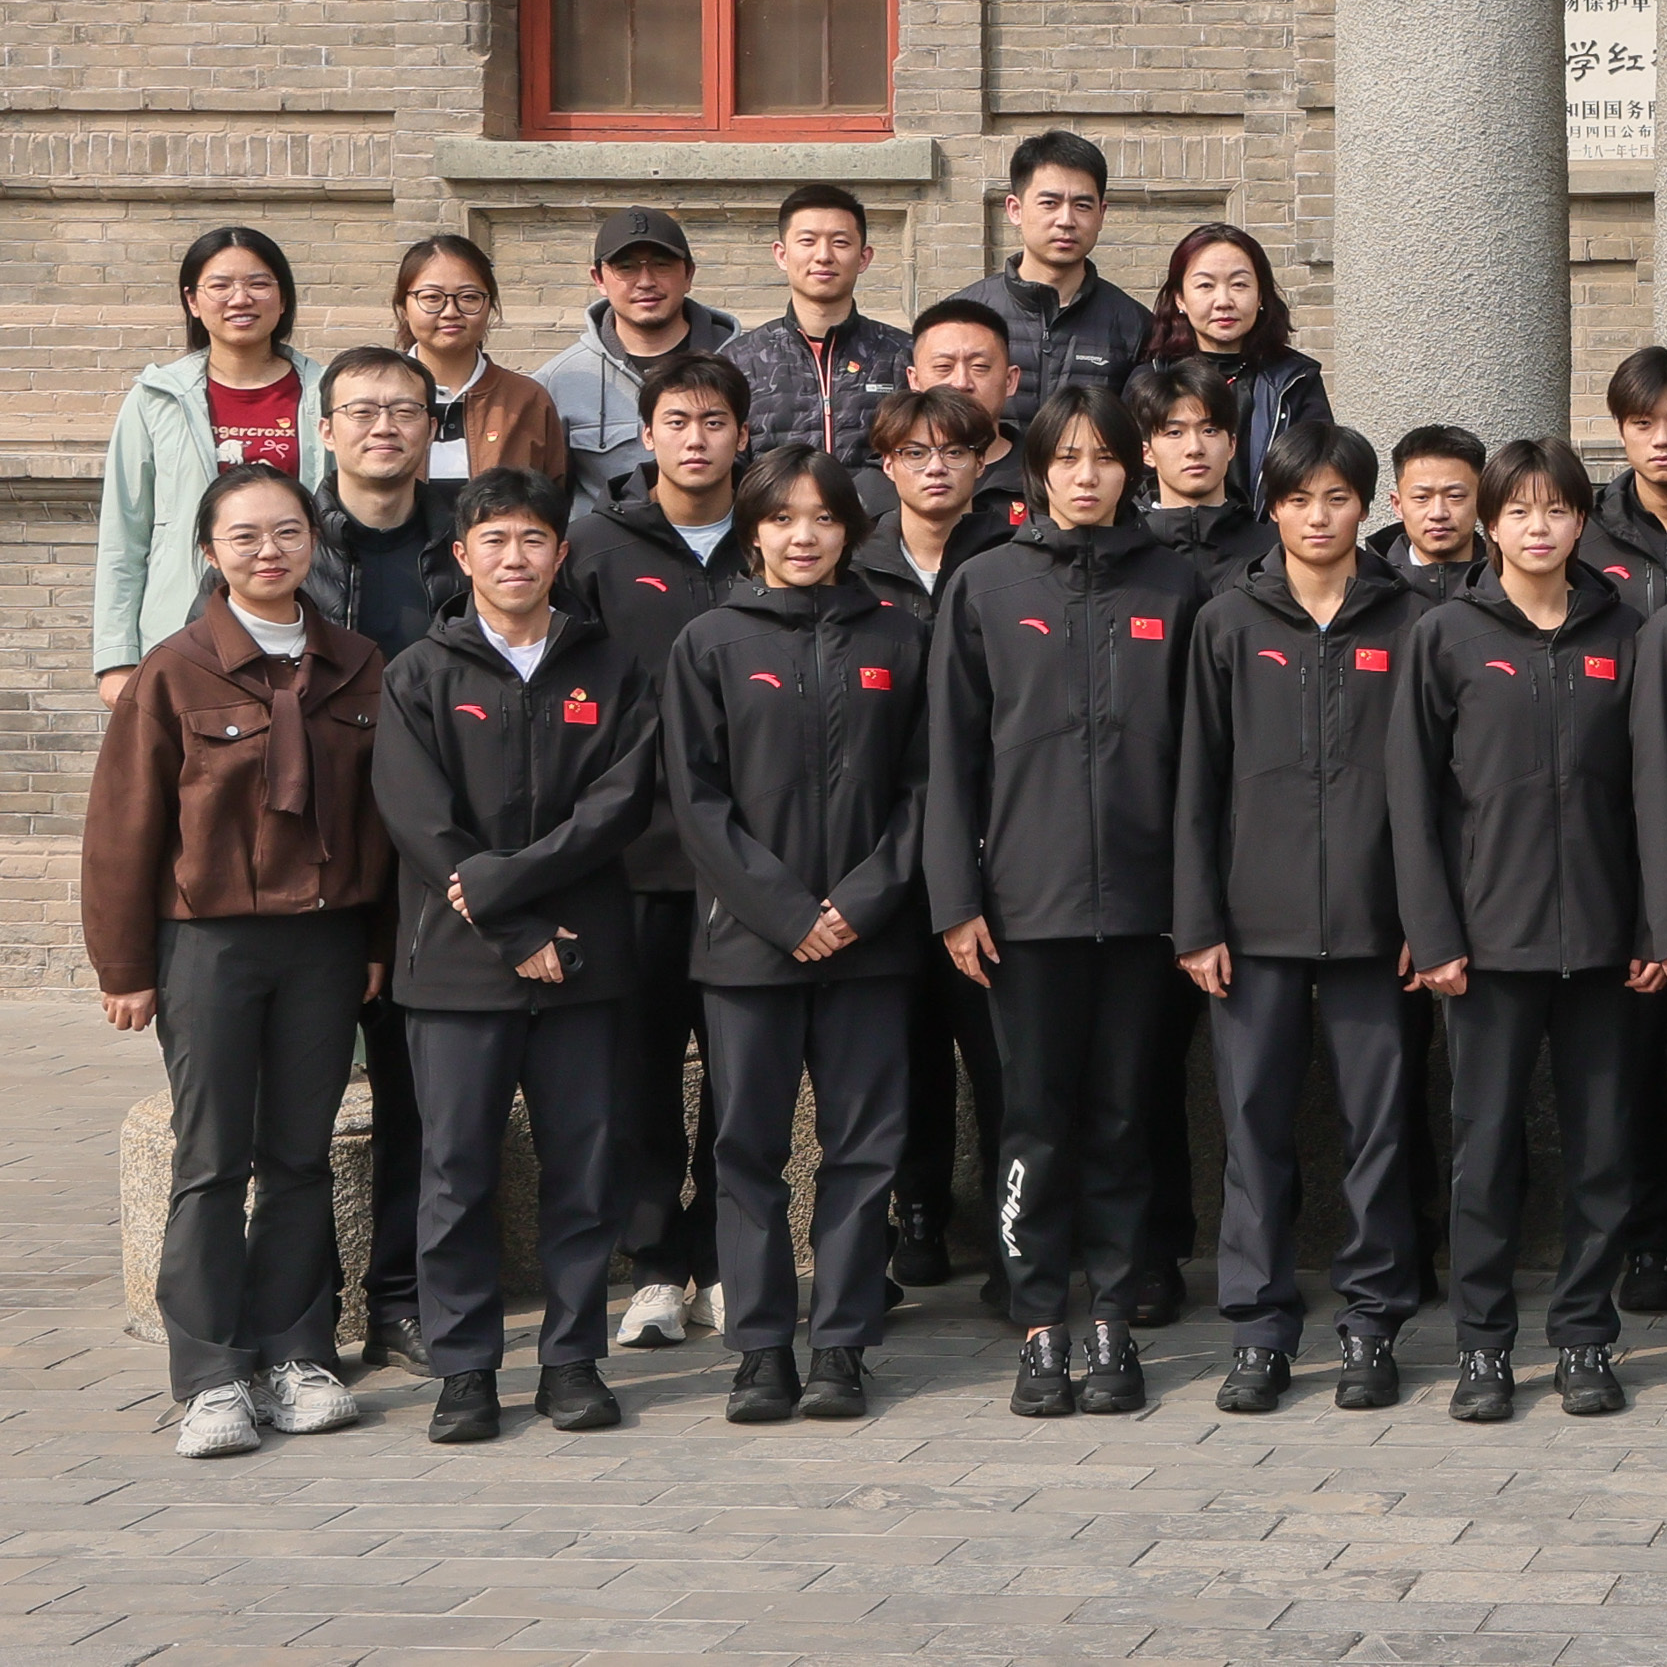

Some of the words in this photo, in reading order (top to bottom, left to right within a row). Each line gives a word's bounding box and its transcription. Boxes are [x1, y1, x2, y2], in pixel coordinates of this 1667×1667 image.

[1566, 40, 1657, 82] 学红
[1567, 144, 1656, 158] 一九八一年七月
[628, 213, 650, 235] B
[1001, 1159, 1025, 1257] CHINA
